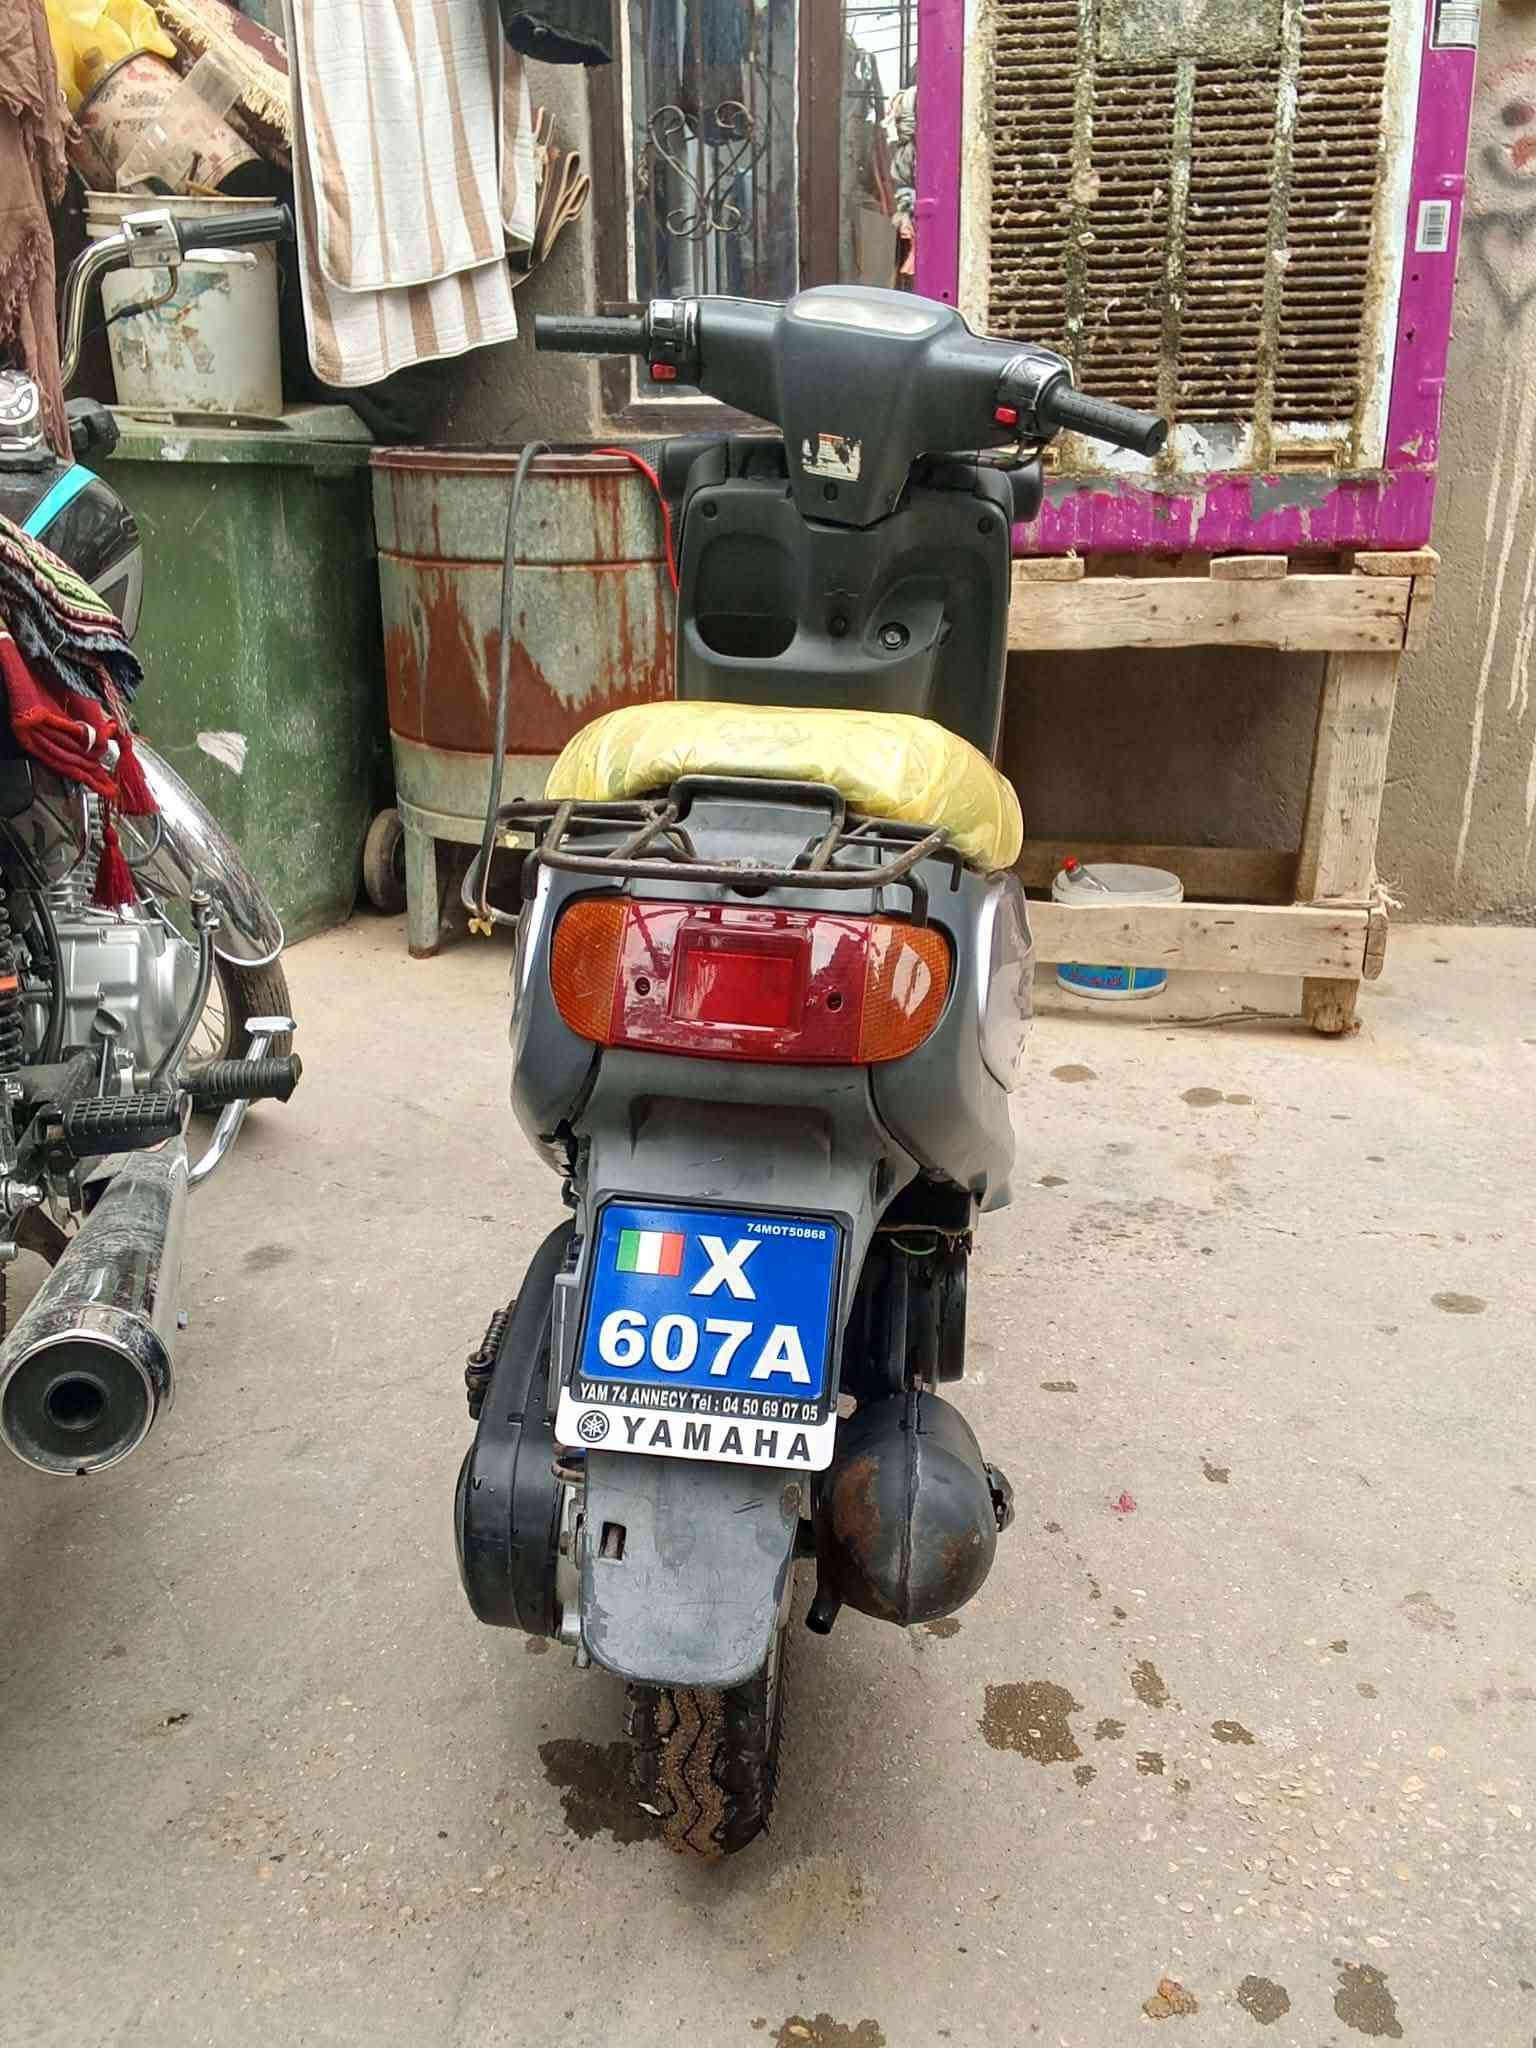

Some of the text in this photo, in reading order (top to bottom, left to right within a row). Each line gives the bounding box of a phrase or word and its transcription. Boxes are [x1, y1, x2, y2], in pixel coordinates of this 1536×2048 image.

[689, 1234, 763, 1300] X
[598, 1309, 811, 1385] 607A
[580, 1382, 609, 1401] YAM
[612, 1385, 627, 1403] 74
[630, 1387, 688, 1409] ANNECY
[723, 1396, 739, 1413] 04
[742, 1398, 758, 1415] 50
[762, 1399, 778, 1417] 69
[782, 1402, 799, 1419] 07
[802, 1404, 818, 1421] 05
[622, 1415, 811, 1462] YAMAHA
